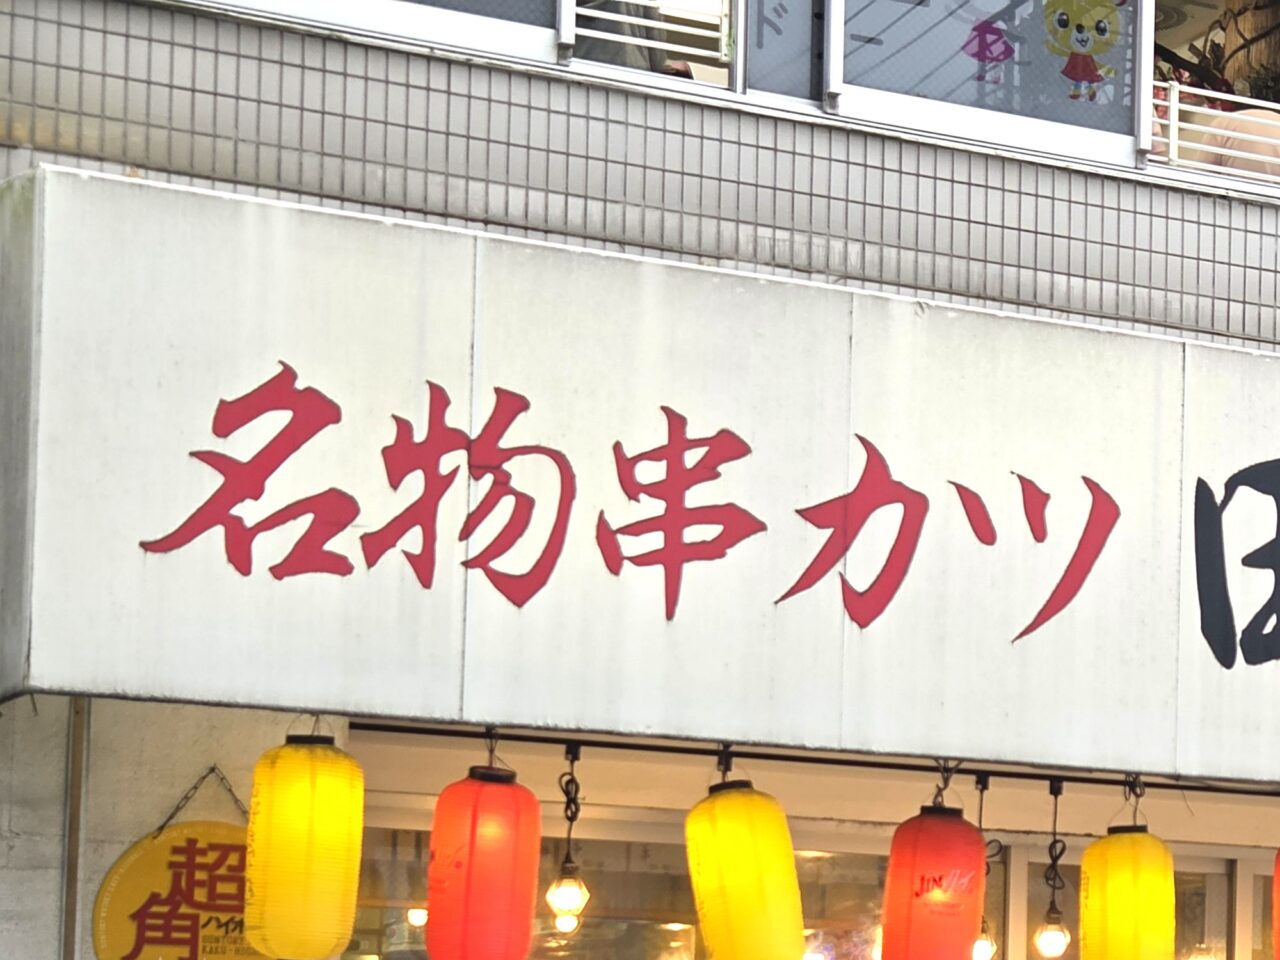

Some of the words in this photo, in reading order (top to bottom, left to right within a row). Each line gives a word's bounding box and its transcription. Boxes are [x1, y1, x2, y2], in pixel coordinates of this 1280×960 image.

[139, 361, 1121, 643] 名物串カツ
